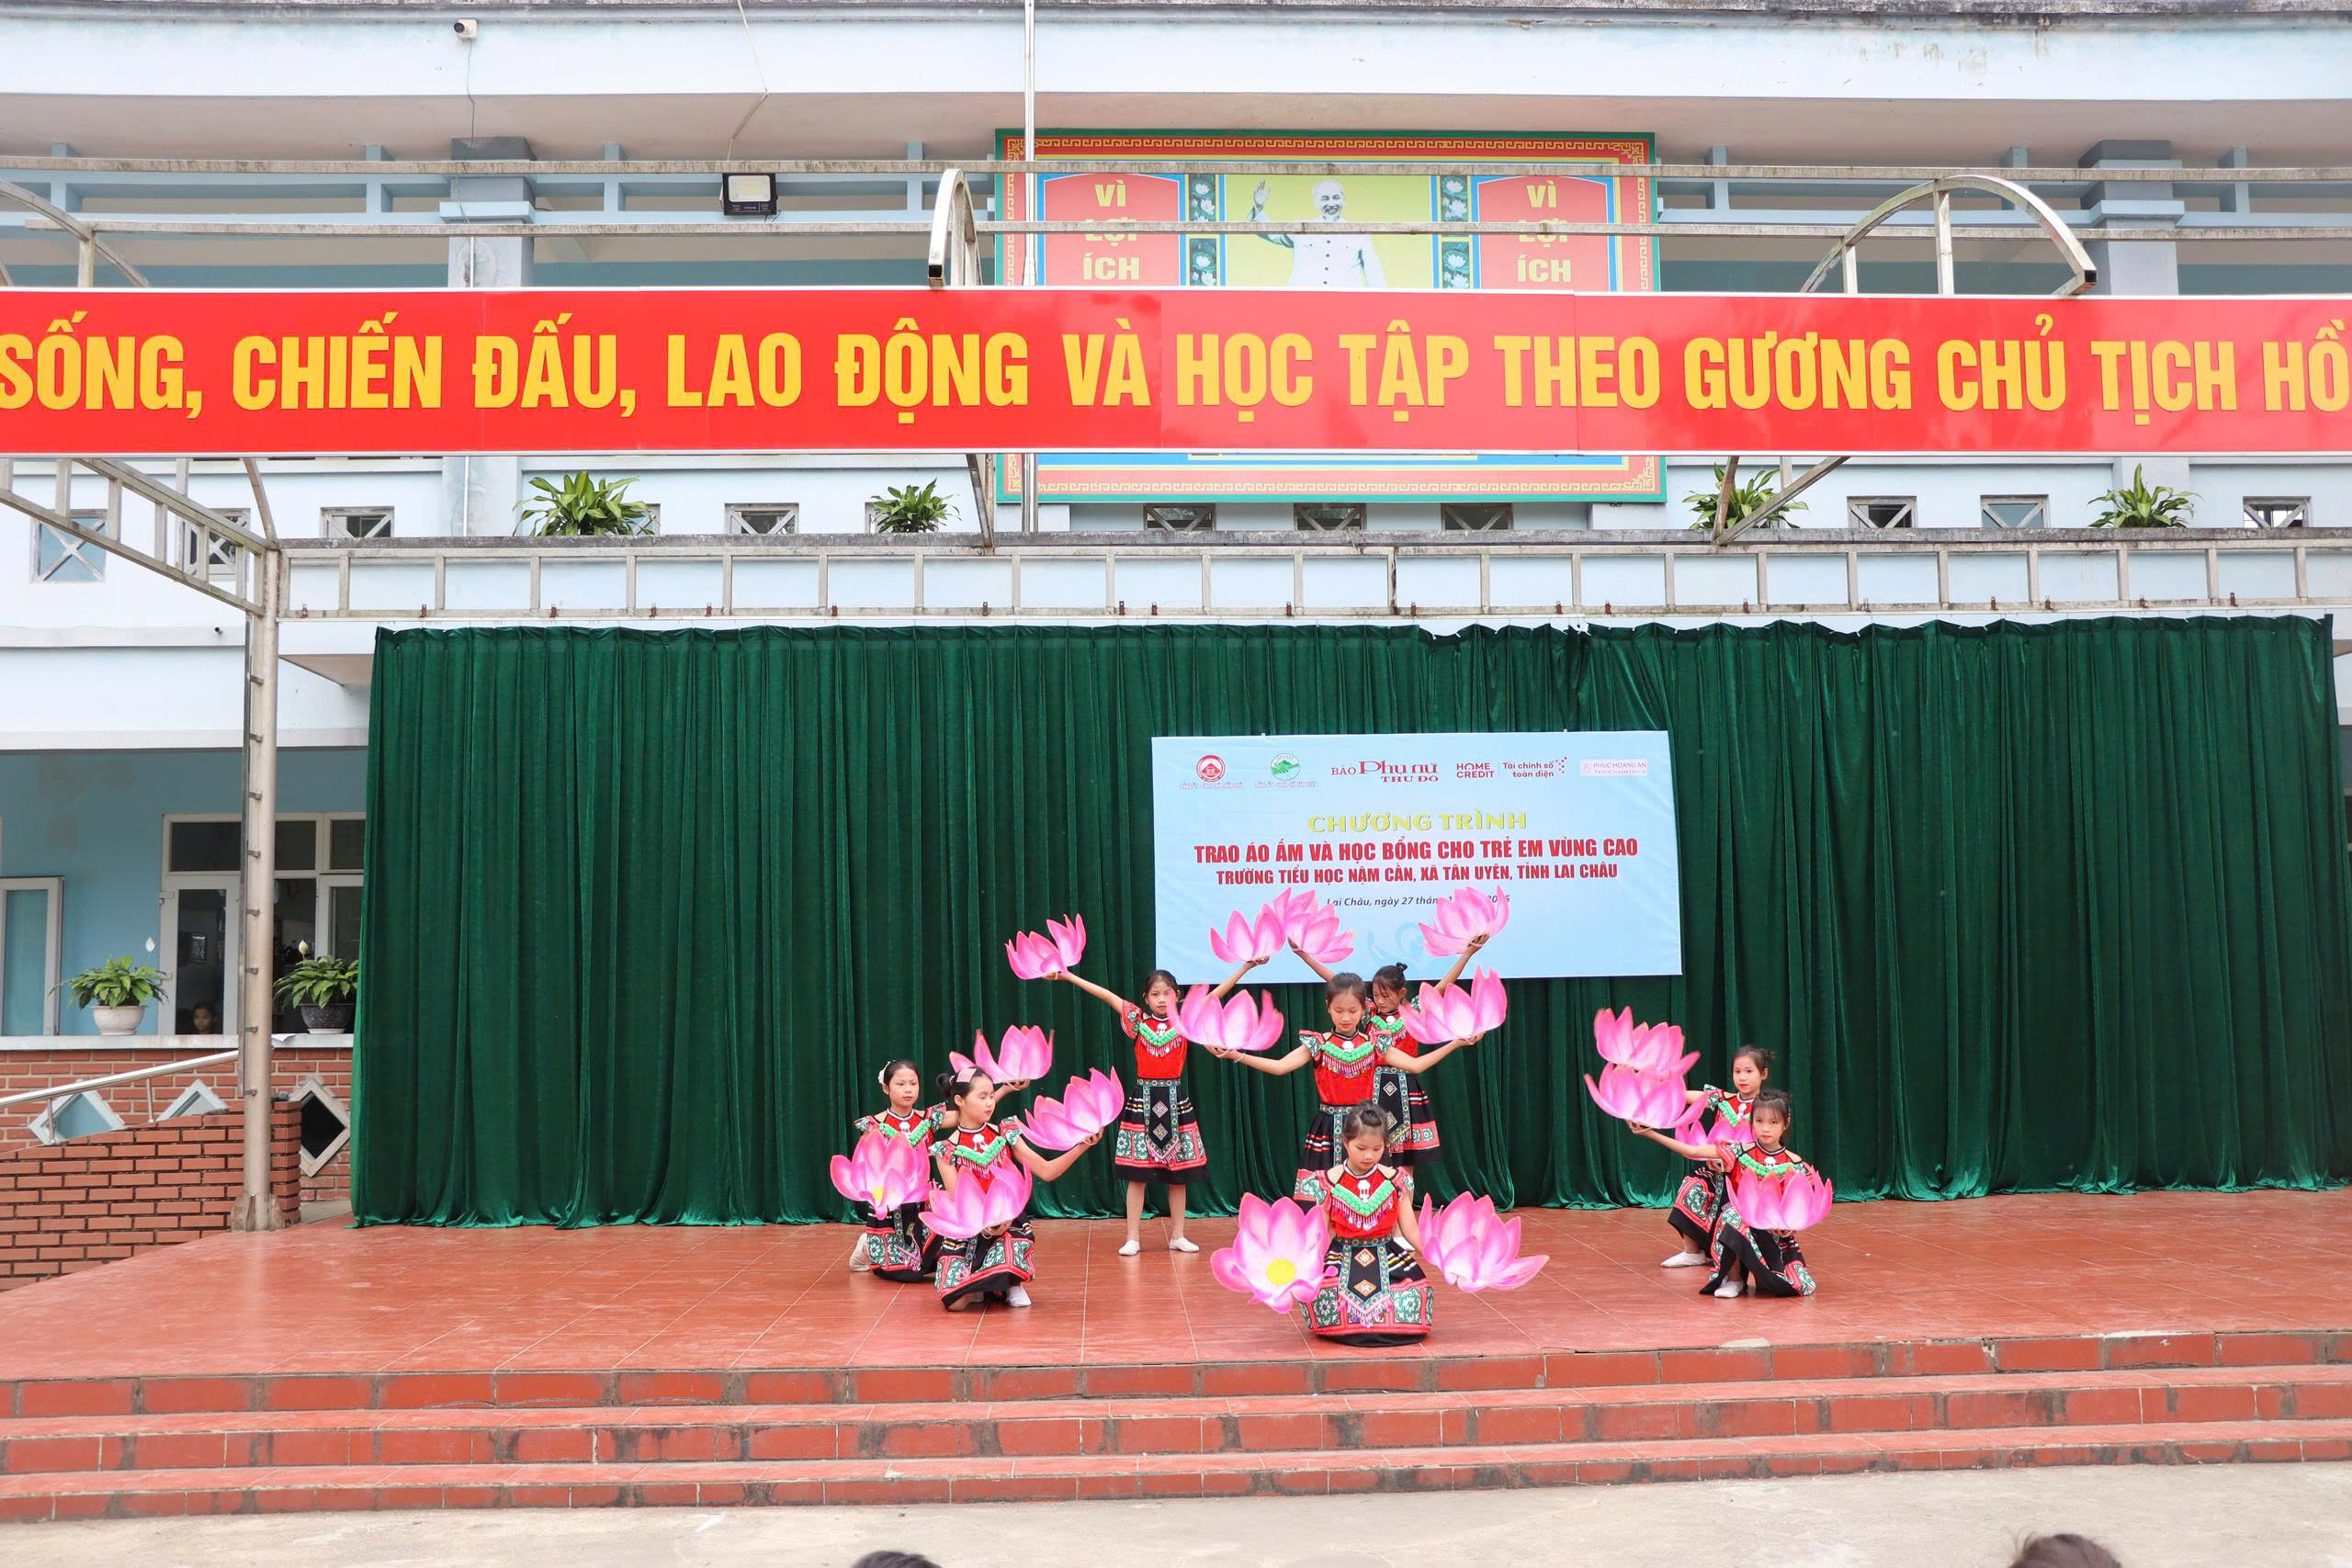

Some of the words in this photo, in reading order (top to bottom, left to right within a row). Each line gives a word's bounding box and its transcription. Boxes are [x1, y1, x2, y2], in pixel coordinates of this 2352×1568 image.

[1094, 179, 1126, 207] VÌ
[1526, 180, 1557, 208] VÌ
[1083, 252, 1140, 280] ÍCH
[1517, 254, 1571, 283] ÍCH
[0, 310, 202, 419] SỐNG,
[232, 311, 443, 411] CHIẾN
[471, 312, 636, 417] ĐẤU,
[667, 332, 802, 407] LAO
[834, 317, 1028, 424] ĐỘNG
[1062, 318, 1151, 406] VÀ
[1176, 333, 1314, 423] HỌC
[1338, 319, 1469, 423] TẬP
[1494, 334, 1660, 409] THEO
[1684, 331, 1912, 411] GƯƠNG
[1937, 313, 2066, 412] CHỦ
[2090, 341, 2237, 425] TỊCH
[2262, 319, 2350, 412] HỒ
[1331, 764, 1356, 775] BÁO
[1456, 762, 1490, 771] HOME
[1456, 771, 1495, 779] CREDIT
[1503, 761, 1515, 770] Tài
[1518, 761, 1542, 770] chính
[1513, 769, 1533, 778] toàn
[1535, 769, 1554, 779] diện
[1307, 812, 1432, 832] CHƯƠNG
[1438, 808, 1527, 830] TRÌNH
[1194, 844, 1239, 863] TRAO
[1246, 841, 1270, 863] ÁO
[1275, 838, 1303, 862] ẤM
[1309, 840, 1333, 862] VÀ
[1339, 842, 1376, 864] HỌC
[1382, 835, 1431, 861] BỔNG
[1437, 841, 1475, 860] CHO
[1480, 835, 1512, 858] TRẺ
[1518, 839, 1544, 857] EM
[1549, 836, 1597, 857] VÙNG
[1603, 838, 1638, 856] CAO
[1216, 866, 1273, 885] TRƯỜNG
[1278, 863, 1309, 884] TIỂU
[1314, 868, 1343, 886] HỌC
[1348, 865, 1379, 885] NẬM
[1385, 863, 1416, 882] CẦN,
[1420, 864, 1439, 881] XÃ
[1442, 863, 1470, 880] TÂN
[1475, 863, 1513, 880] UYÊN,
[1516, 861, 1550, 879] TỈNH
[1555, 863, 1575, 878] LAI
[1579, 862, 1618, 878] CHÂU
[1344, 897, 1372, 907] Châu,
[1374, 897, 1399, 908] ngày
[1401, 897, 1413, 905] 27
[1416, 896, 1439, 905] thán
